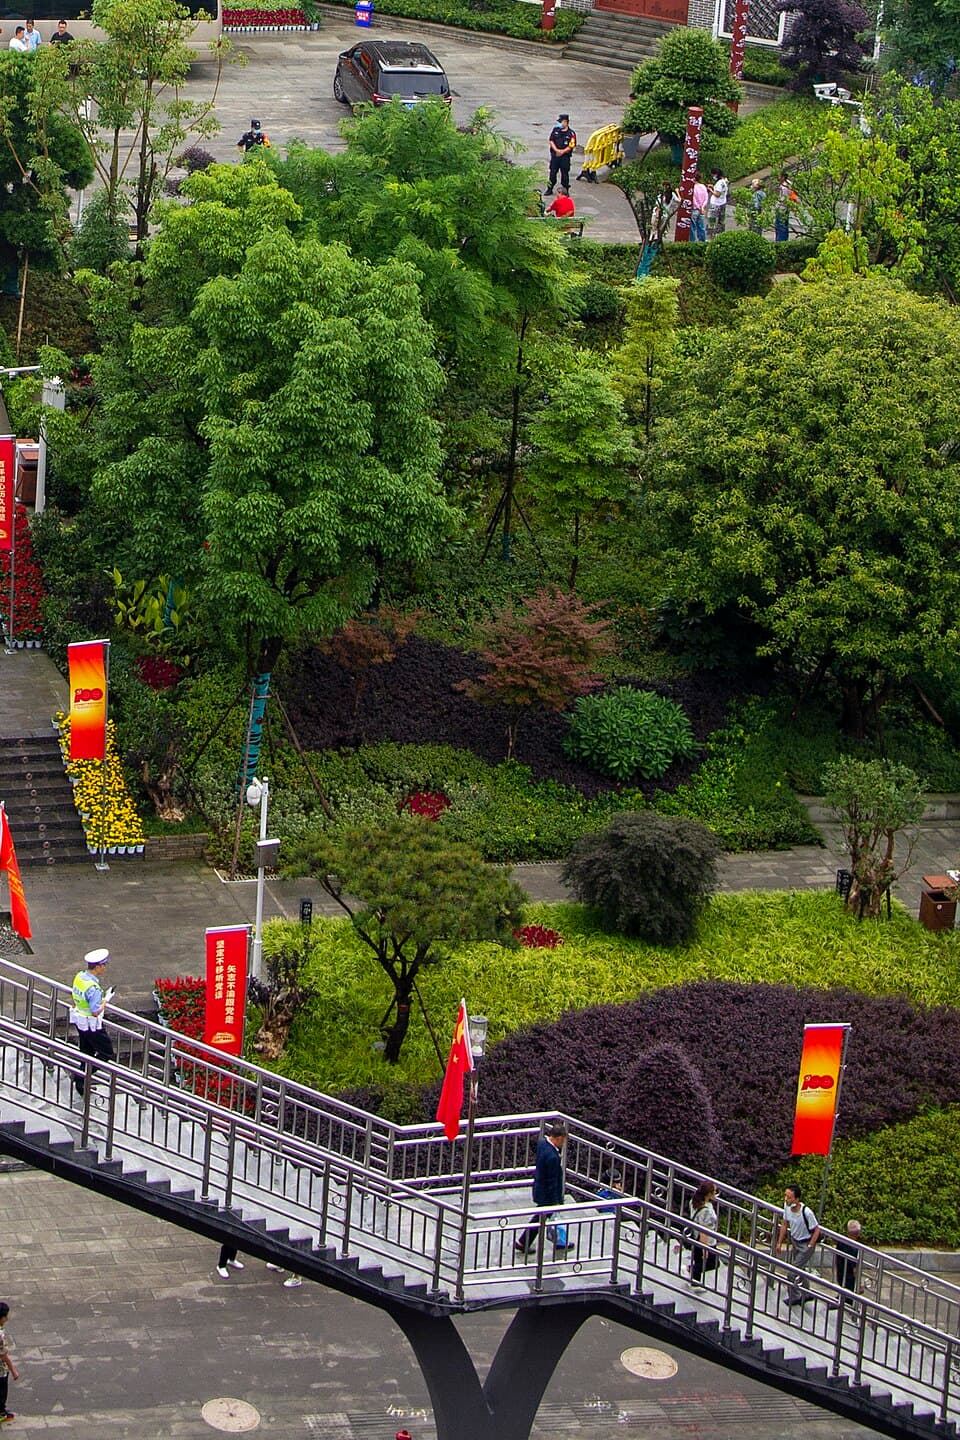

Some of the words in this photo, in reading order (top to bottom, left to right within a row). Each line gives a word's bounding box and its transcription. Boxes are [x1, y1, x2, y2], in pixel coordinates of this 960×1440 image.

[215, 940, 225, 999] 坚定不移听党话
[225, 965, 237, 1024] 矢志不渝跟党走
